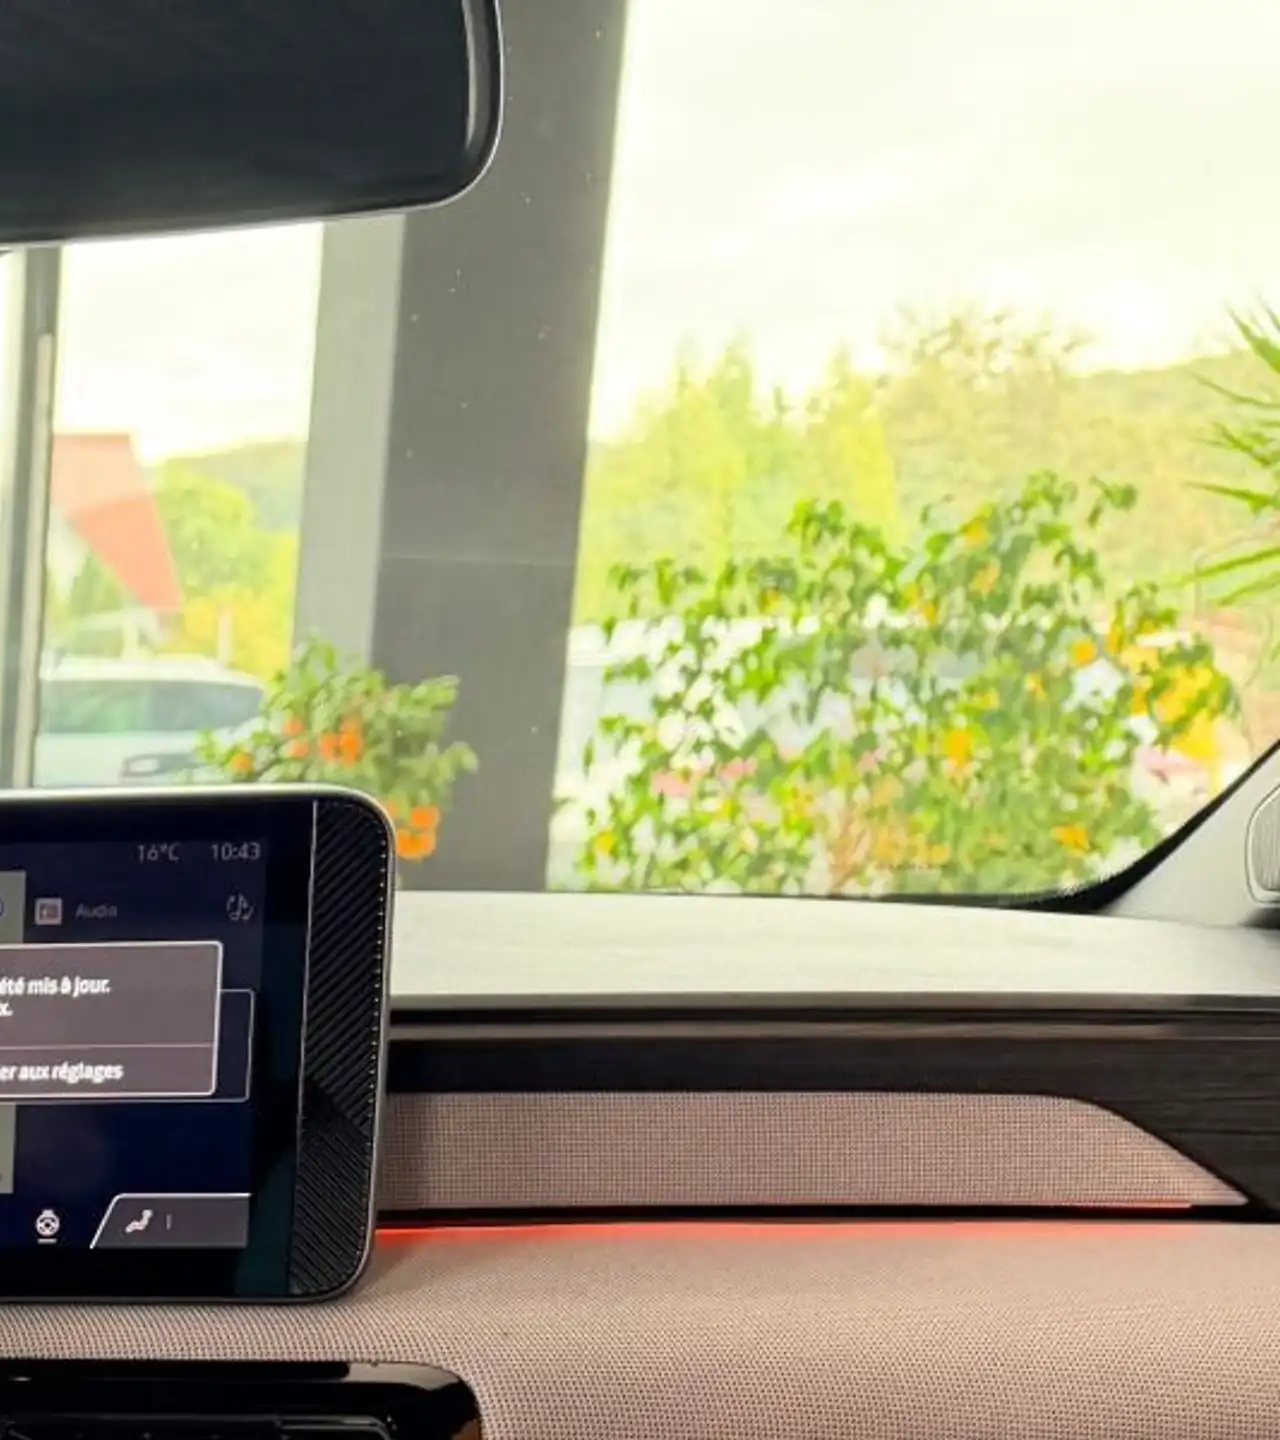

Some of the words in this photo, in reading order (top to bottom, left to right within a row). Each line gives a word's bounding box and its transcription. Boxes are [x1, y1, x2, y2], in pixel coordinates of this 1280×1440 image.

[138, 843, 181, 863] 16°C
[211, 842, 261, 860] 10:43
[27, 977, 58, 995] mis
[60, 975, 72, 994] à
[73, 976, 111, 998] jour.
[18, 1064, 49, 1081] aux
[51, 1060, 123, 1084] réglages
